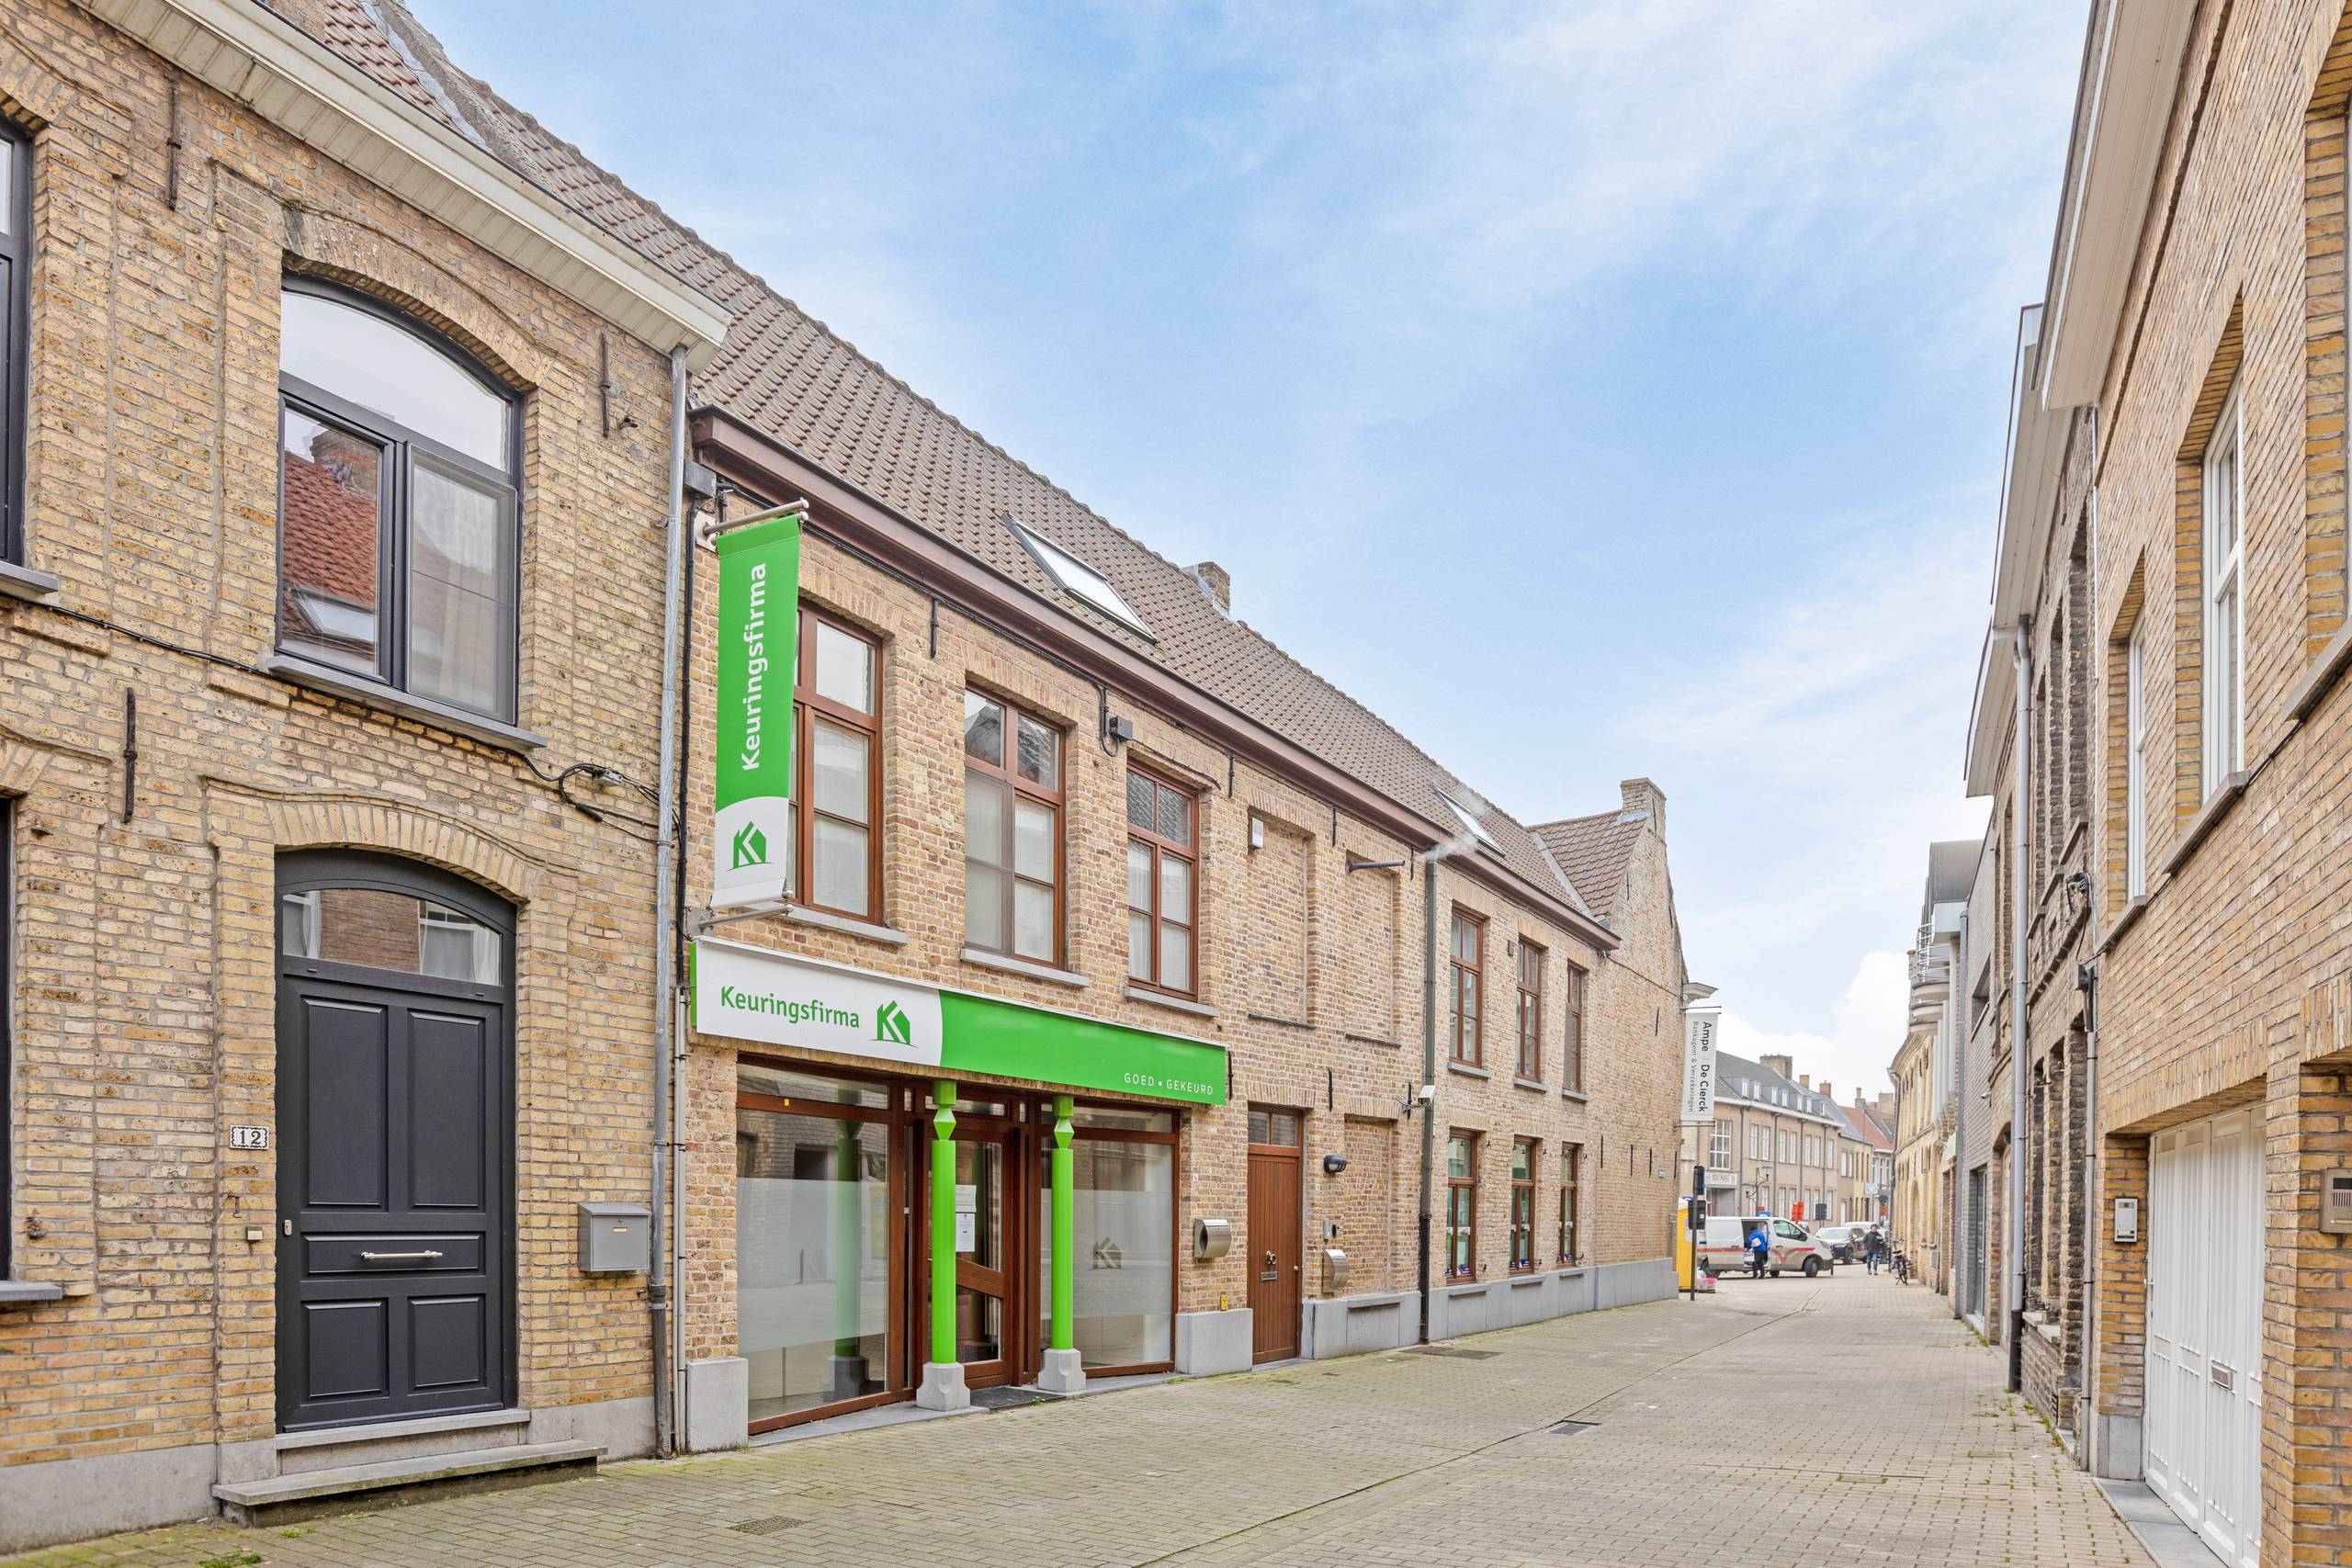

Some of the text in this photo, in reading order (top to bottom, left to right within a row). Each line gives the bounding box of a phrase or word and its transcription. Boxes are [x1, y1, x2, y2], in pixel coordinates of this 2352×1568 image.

[741, 562, 767, 772] Keuringsfirma
[719, 986, 860, 1029] Keuringsfirma
[1690, 1021, 1700, 1055] Bankagent
[1701, 1021, 1713, 1052] Ampe
[1124, 1072, 1214, 1096] GOED GEKEURD
[1700, 1065, 1711, 1077] De
[1688, 1065, 1697, 1112] Verzekeringen
[1698, 1080, 1710, 1112] Clerck
[240, 1130, 262, 1145] 12
